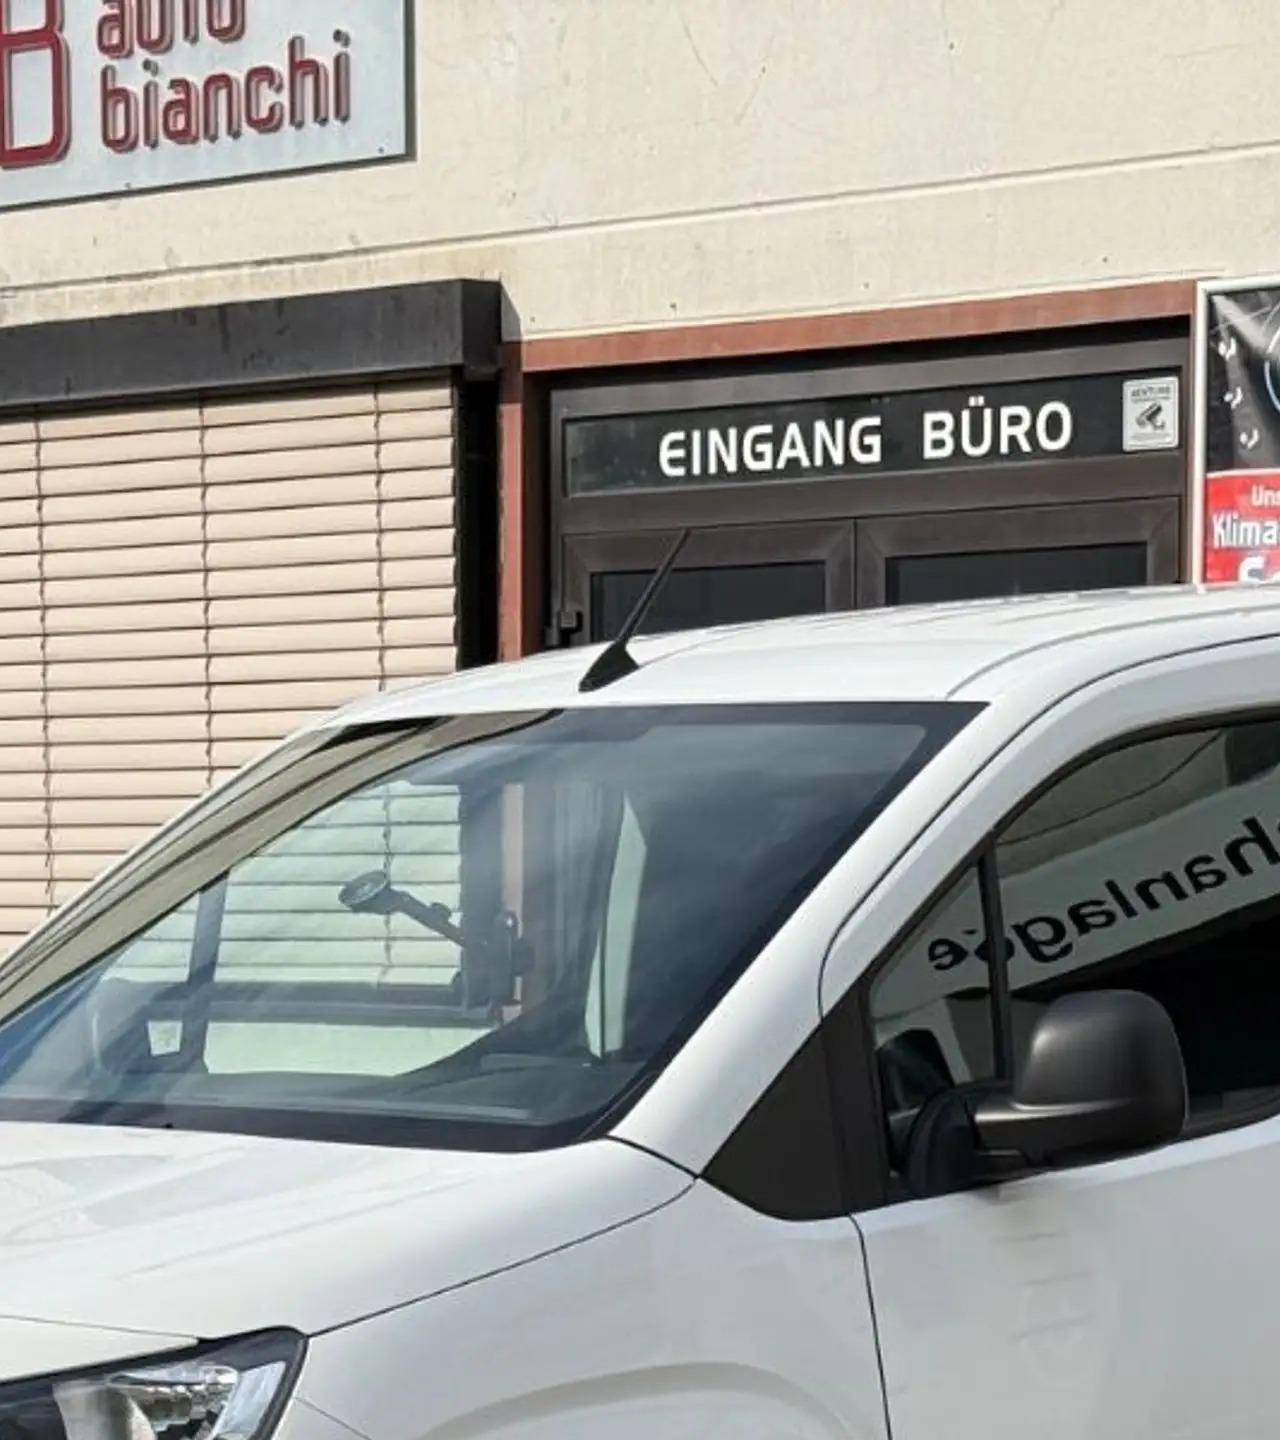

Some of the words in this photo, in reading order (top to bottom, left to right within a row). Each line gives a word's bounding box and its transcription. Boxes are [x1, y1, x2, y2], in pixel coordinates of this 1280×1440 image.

[100, 30, 352, 153] bianchi
[658, 415, 883, 478] EINGANG
[922, 394, 1073, 460] BÜRO
